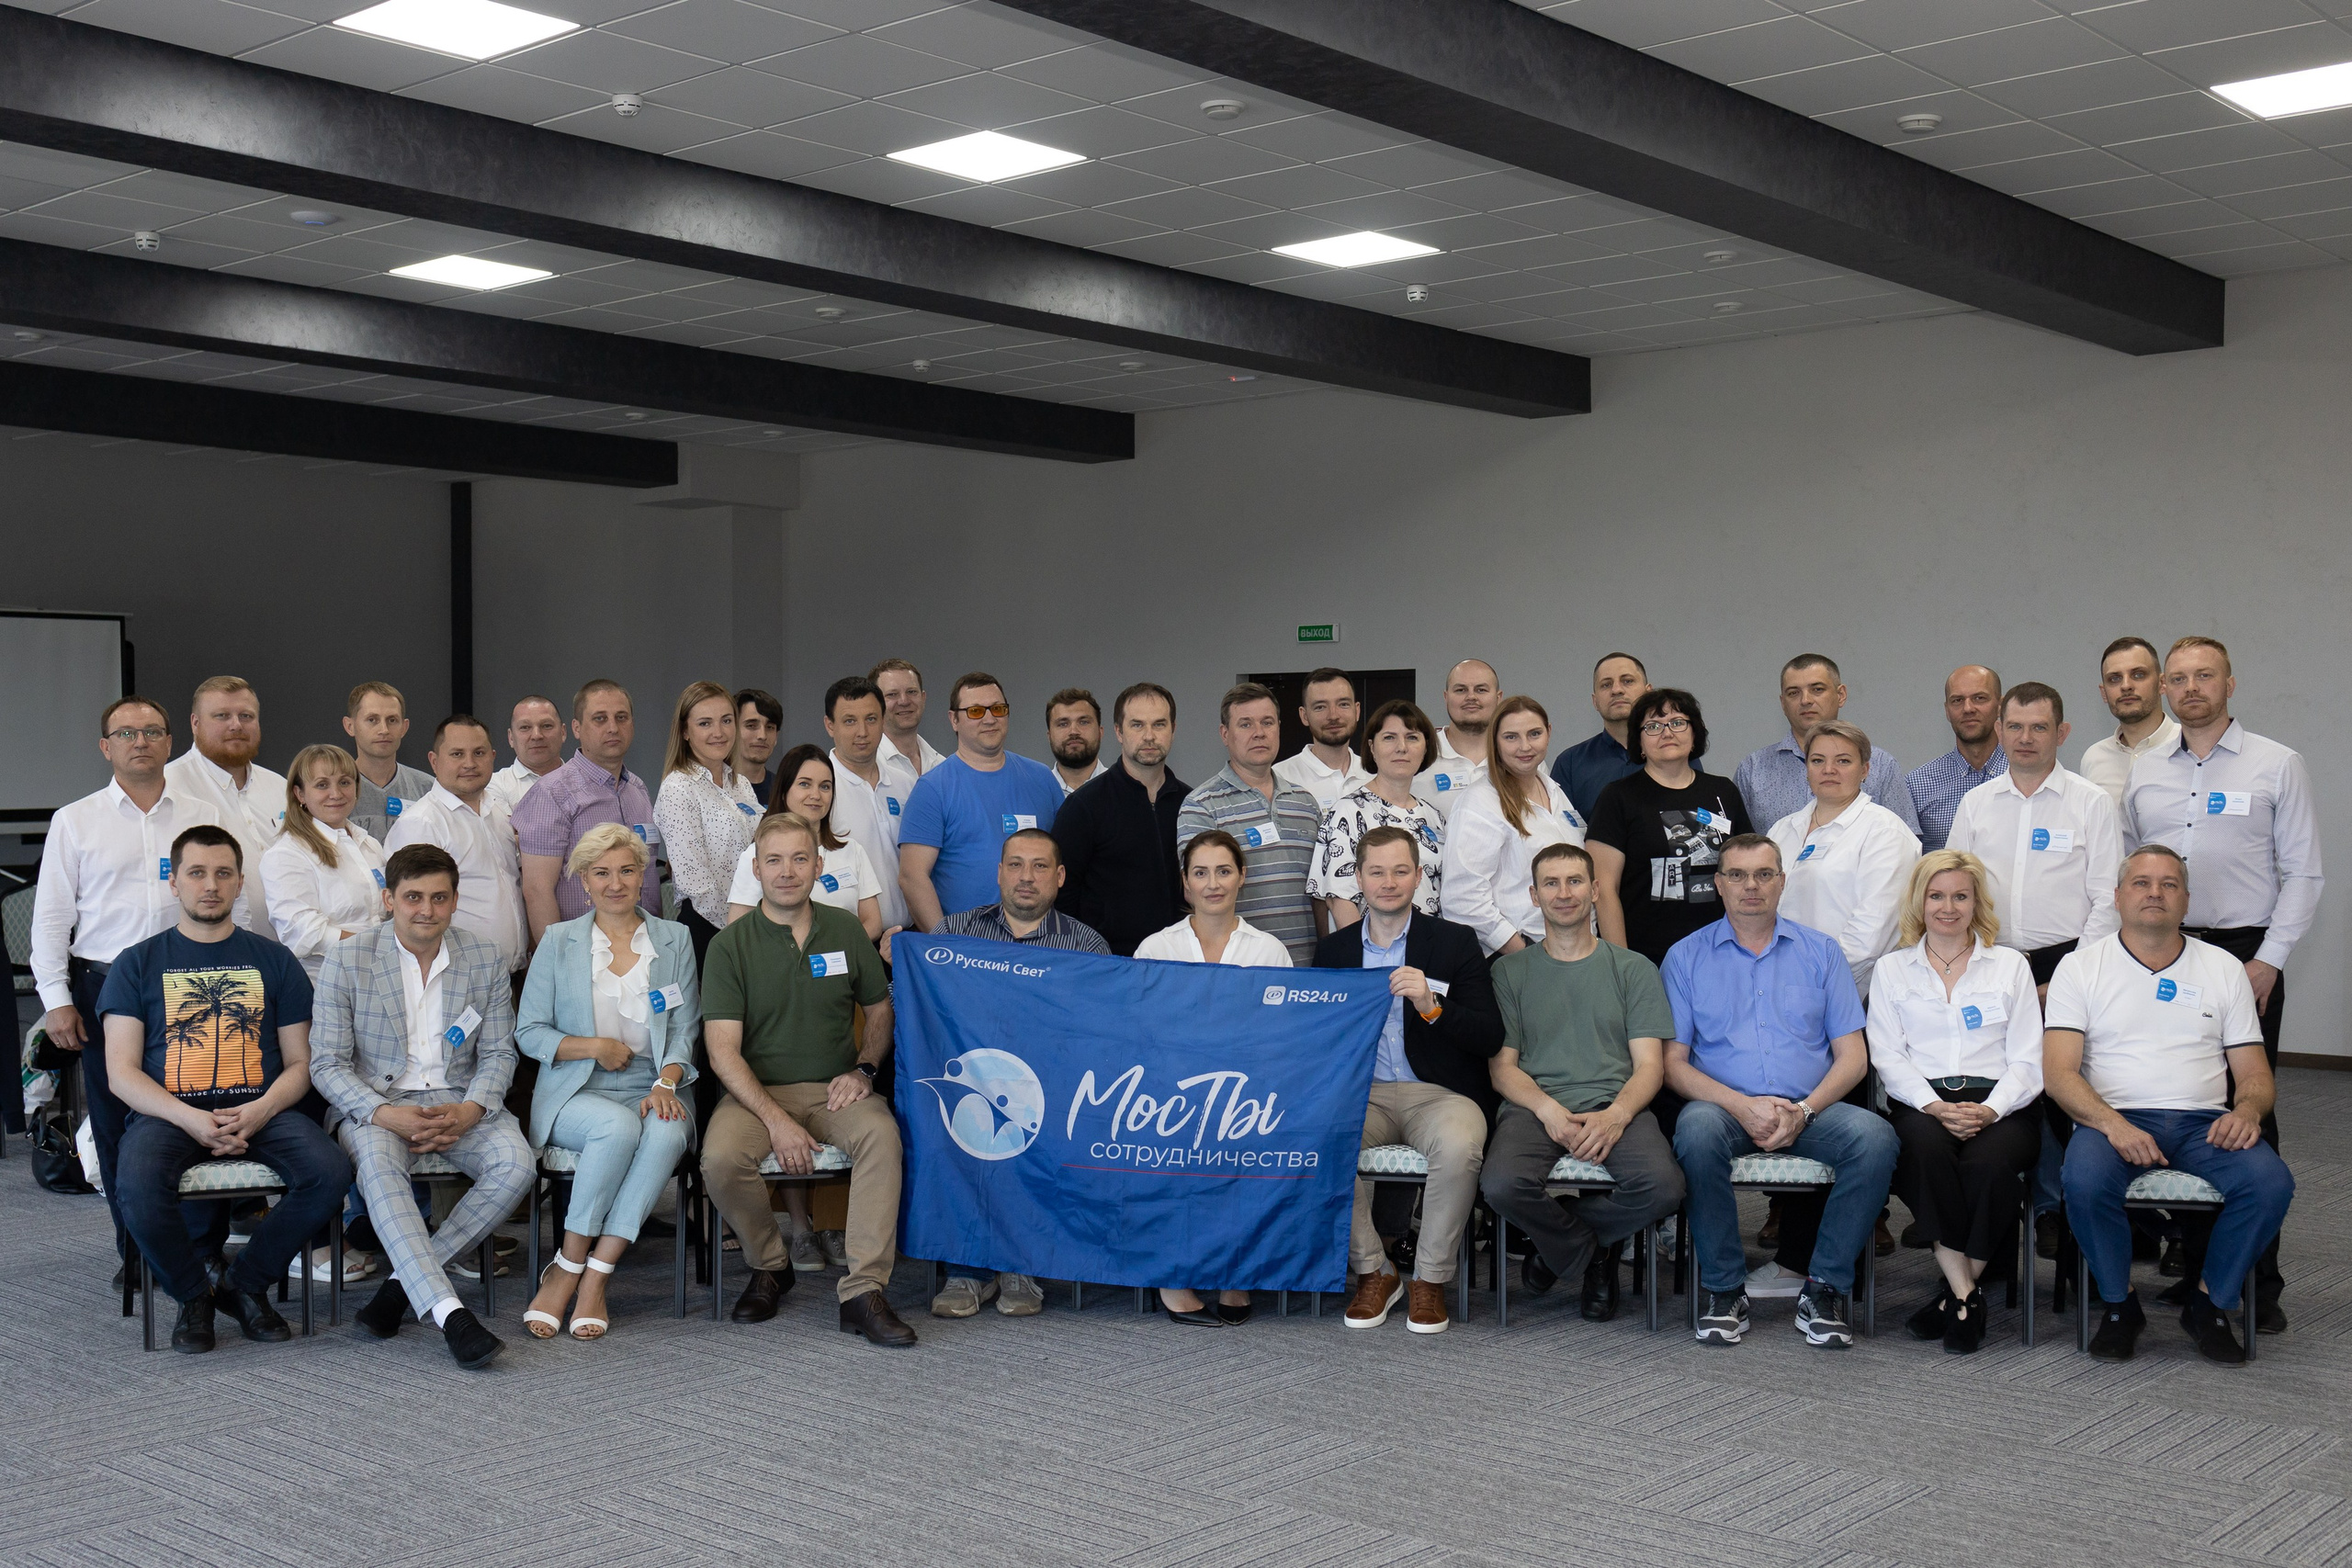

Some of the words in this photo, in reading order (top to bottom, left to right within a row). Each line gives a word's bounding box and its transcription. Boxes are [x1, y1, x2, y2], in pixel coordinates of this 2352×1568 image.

[1300, 628, 1330, 638] ВЫХОД
[956, 953, 1010, 972] Русский
[1287, 989, 1348, 1002] RS24.ru
[1090, 1142, 1319, 1168] сотрудничества
